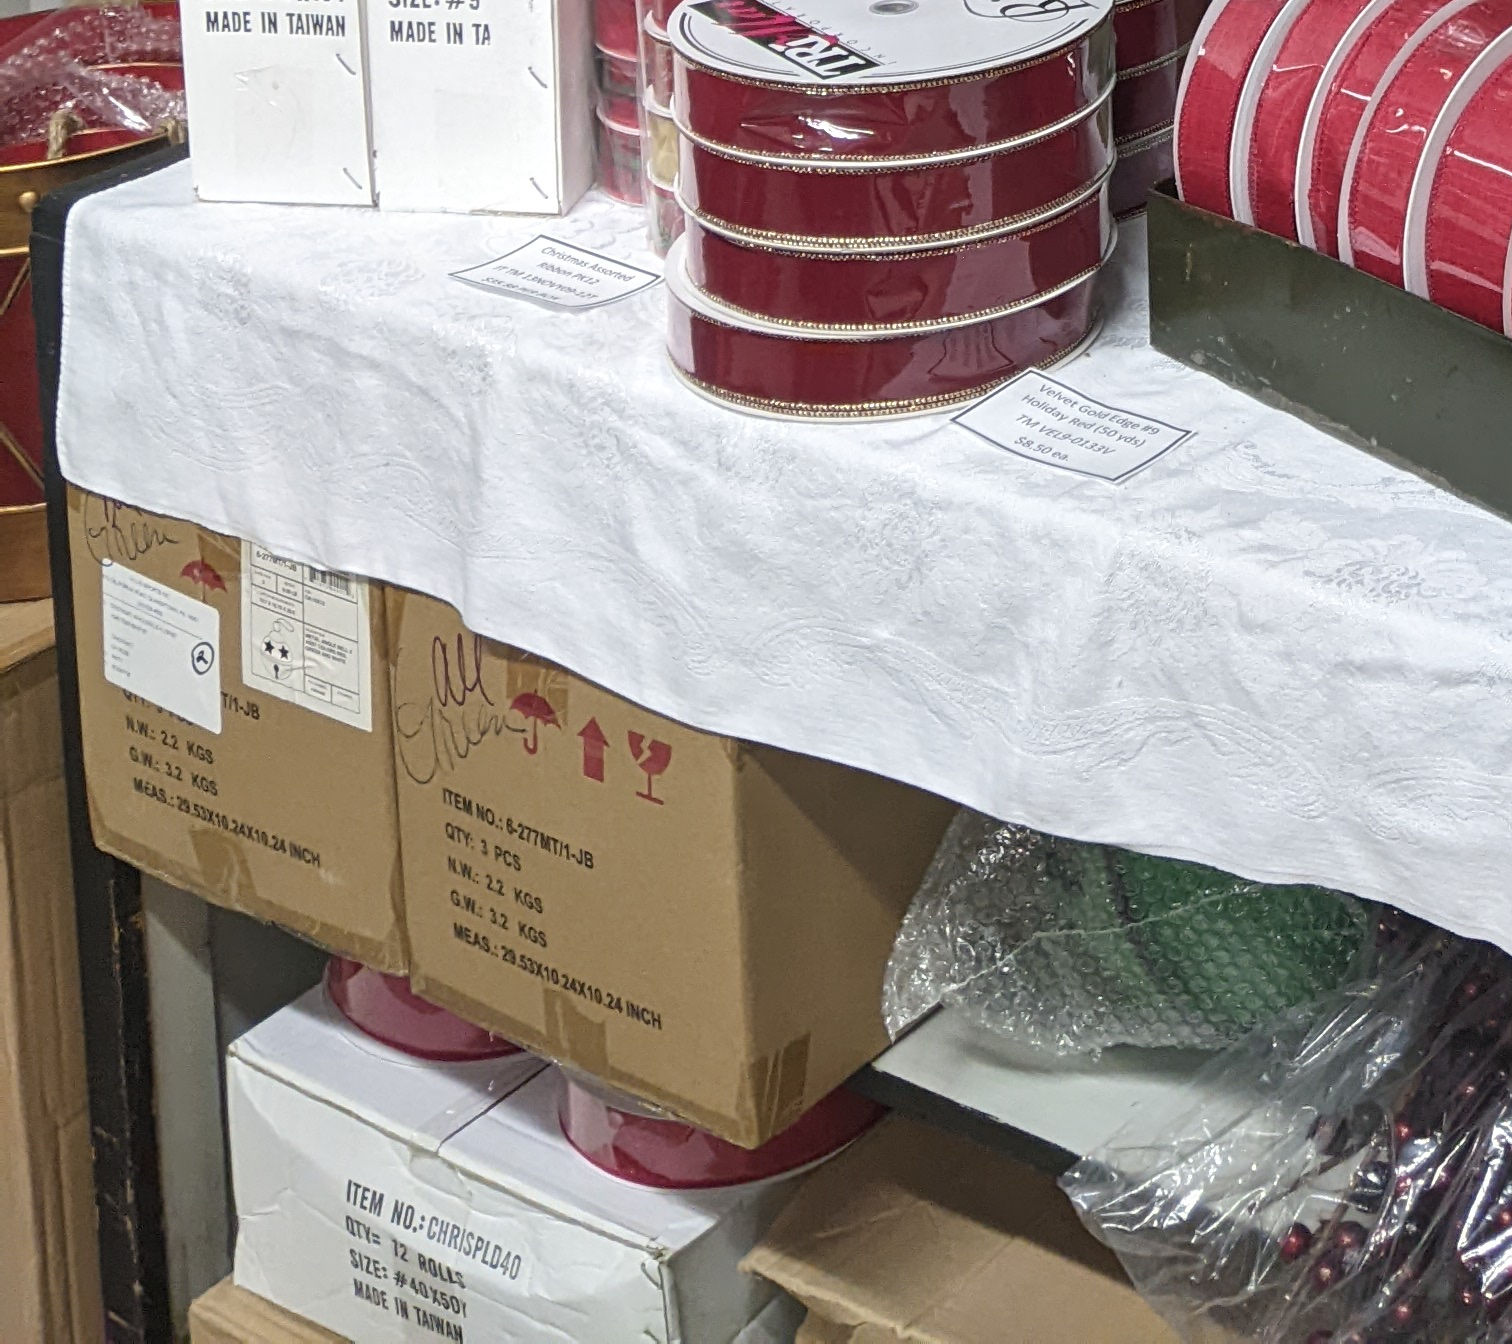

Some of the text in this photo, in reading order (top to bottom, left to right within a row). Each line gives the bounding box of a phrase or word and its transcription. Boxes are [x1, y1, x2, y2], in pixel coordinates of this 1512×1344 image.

[205, 11, 346, 38] MADE IN TAIWAN
[390, 21, 437, 43] MADE
[446, 23, 463, 44] IN
[537, 262, 599, 285] Ribbon PK12
[541, 247, 635, 282] Christmas Assorted
[1015, 414, 1116, 455] TM VEL9-0133V
[1021, 394, 1147, 448] Holiday Red (50 yds)
[1039, 384, 1160, 436] Velvet Gold Edge #9
[1014, 436, 1070, 462] $8.50 ea.
[126, 715, 214, 764] N.W.: 2.2 KGS
[129, 747, 160, 772] G.W.:
[191, 773, 218, 796] KGS
[134, 777, 174, 808] MEAS.:
[289, 841, 320, 867] INCH
[442, 787, 594, 869] ITEM NO.: 6-277MT/1-JB
[445, 822, 522, 872] QTY: 3 PCS
[448, 856, 543, 914] N.W.: 2.2 KGS
[450, 889, 483, 918] G.W.:
[518, 921, 548, 948] KGS
[453, 922, 499, 957] MEAS.:
[626, 1000, 662, 1030] INCH
[346, 1179, 384, 1217] ITEM
[345, 1215, 467, 1289] QTY= 12 ROLLS
[349, 1248, 467, 1318] SIZE: #40X50Y
[353, 1278, 463, 1344] MADE IN TAIWAN
